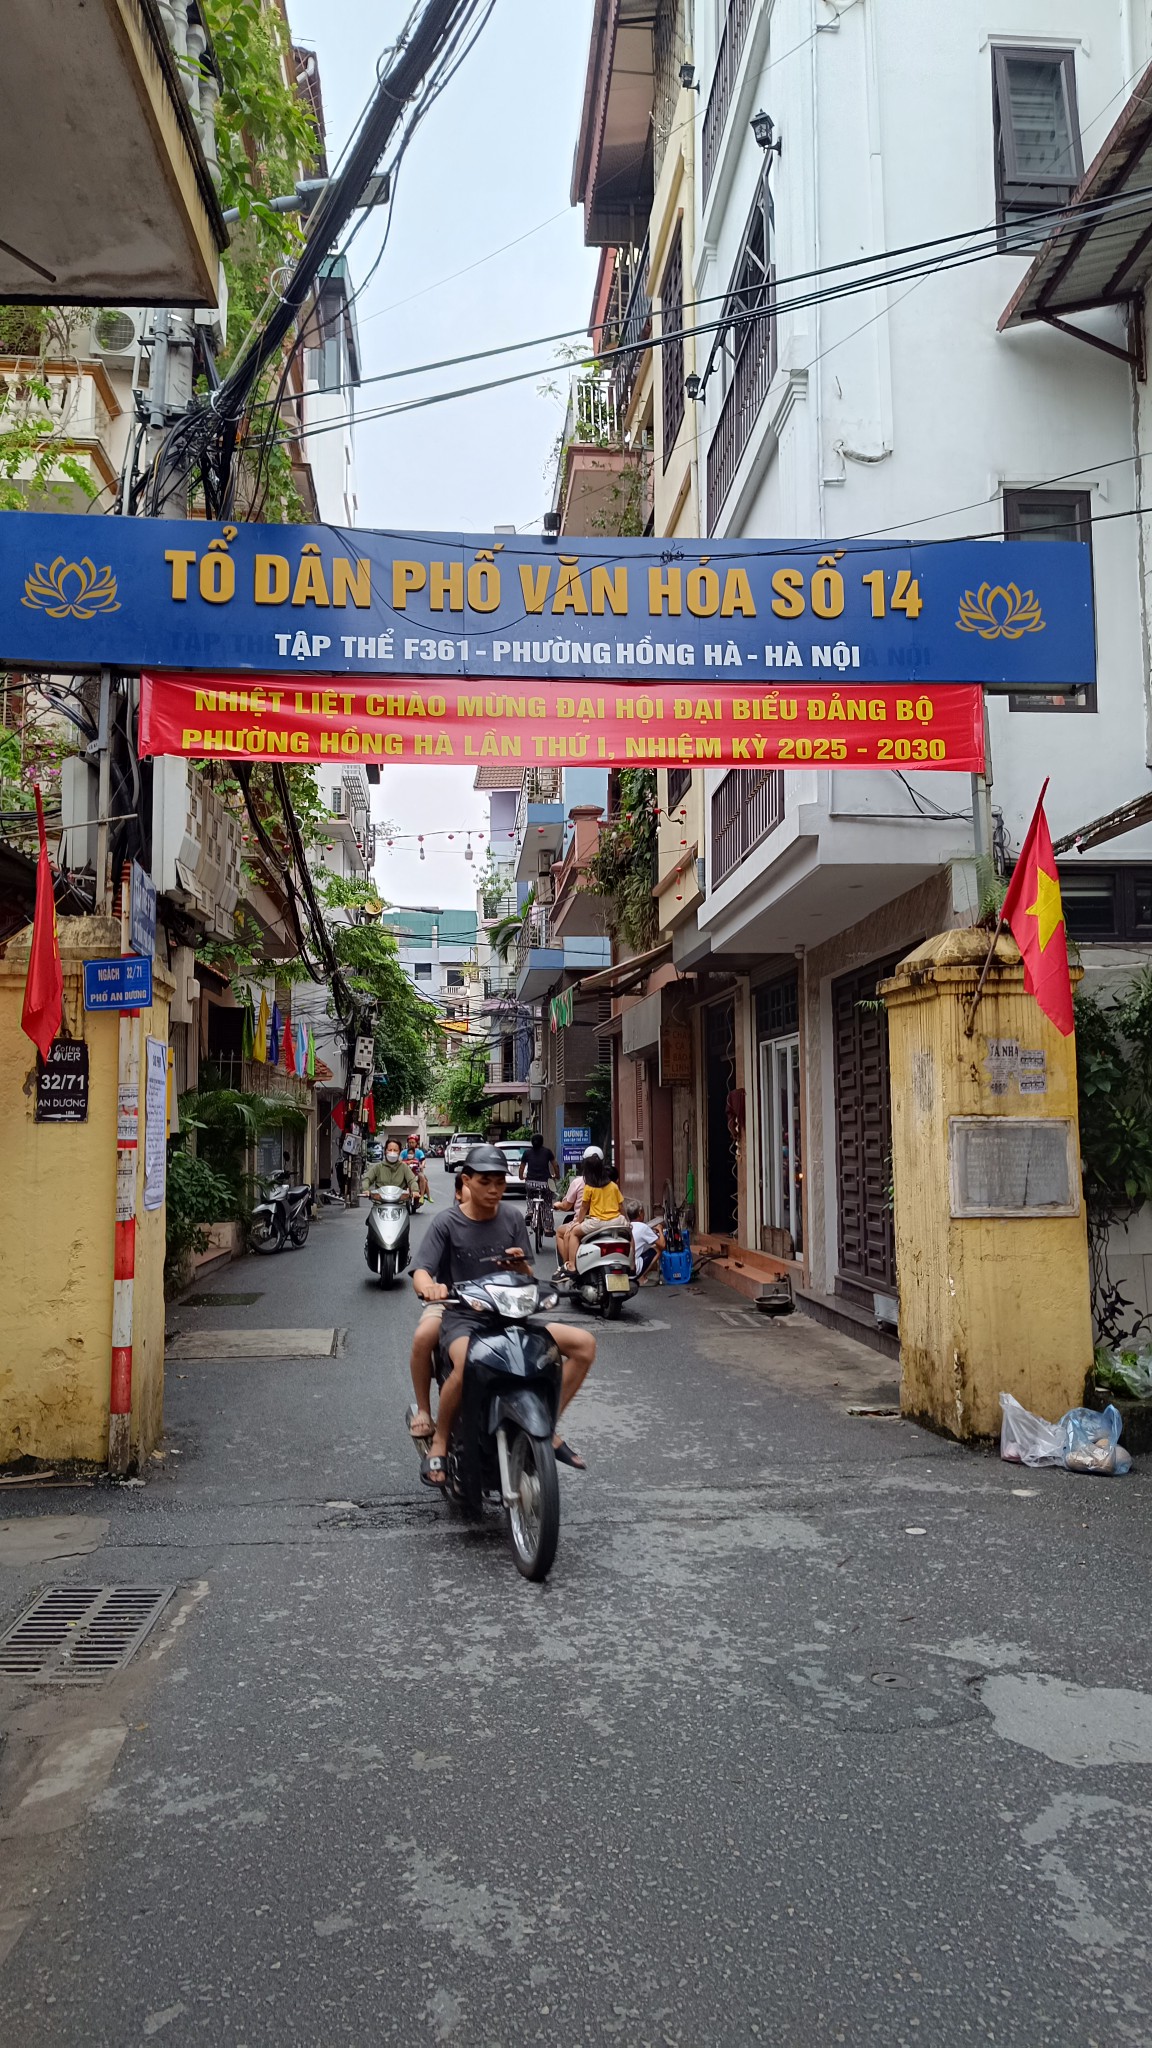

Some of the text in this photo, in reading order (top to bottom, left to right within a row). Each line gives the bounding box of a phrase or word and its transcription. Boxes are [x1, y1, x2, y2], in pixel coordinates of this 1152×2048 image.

[164, 524, 924, 619] TỔ DÂN PHỐ VĂN HÓA SỐ 14
[275, 630, 332, 662] TẬP
[340, 628, 395, 661] THỂ
[404, 638, 470, 663] F361
[493, 636, 611, 667] PHƯỜNG
[616, 634, 696, 668] HỒNG
[704, 640, 743, 668] HÀ
[765, 640, 804, 668] HÀ
[811, 641, 862, 673] NỘI
[194, 688, 934, 727] NHIỆT LIỆT CHÀO MỪNG ĐẠI HỘI ĐẠI BIỂU ĐẢNG BỘ
[181, 728, 309, 753] PHƯỜNG
[320, 725, 403, 755] HỒNG
[414, 729, 455, 756] HÀ
[465, 728, 521, 757] LẦN
[531, 731, 588, 758] THỨ
[598, 739, 616, 762] I,
[625, 733, 721, 763] NHIỆM
[732, 731, 768, 760] KỲ
[778, 738, 847, 760] 2025
[877, 739, 946, 761] 2030
[98, 965, 142, 981] NGÁCH 32/71
[90, 990, 147, 1003] PHỐ AN DƯƠNG
[55, 1044, 80, 1052] Coffee
[41, 1073, 85, 1090] 32/71
[38, 1098, 86, 1108] AN DƯƠNG
